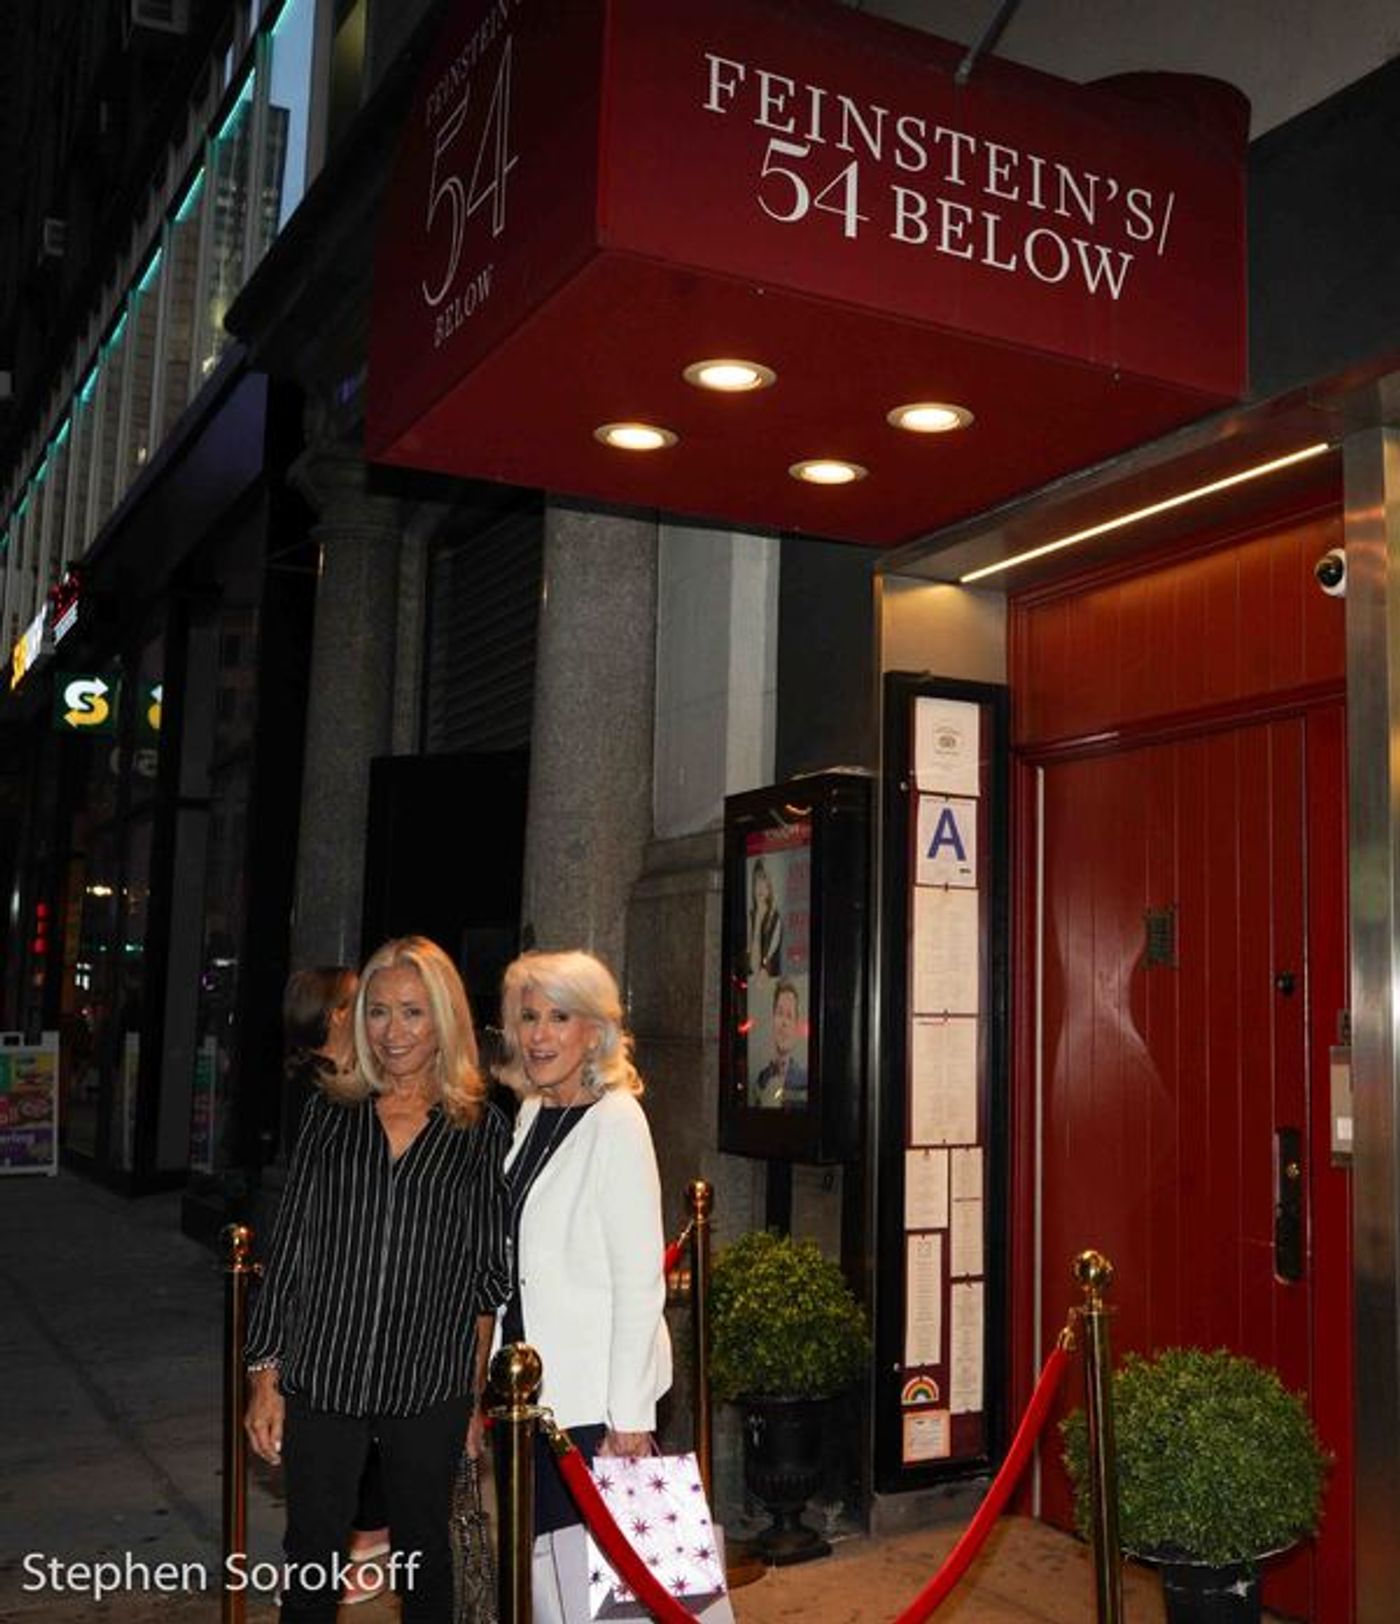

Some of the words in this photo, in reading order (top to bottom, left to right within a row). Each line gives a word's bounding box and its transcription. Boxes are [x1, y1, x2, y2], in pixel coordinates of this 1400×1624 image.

[422, 33, 519, 305] 54
[757, 137, 870, 239] 54
[889, 184, 1135, 300] BELOW
[434, 263, 494, 349] BELOW
[926, 807, 967, 862] A
